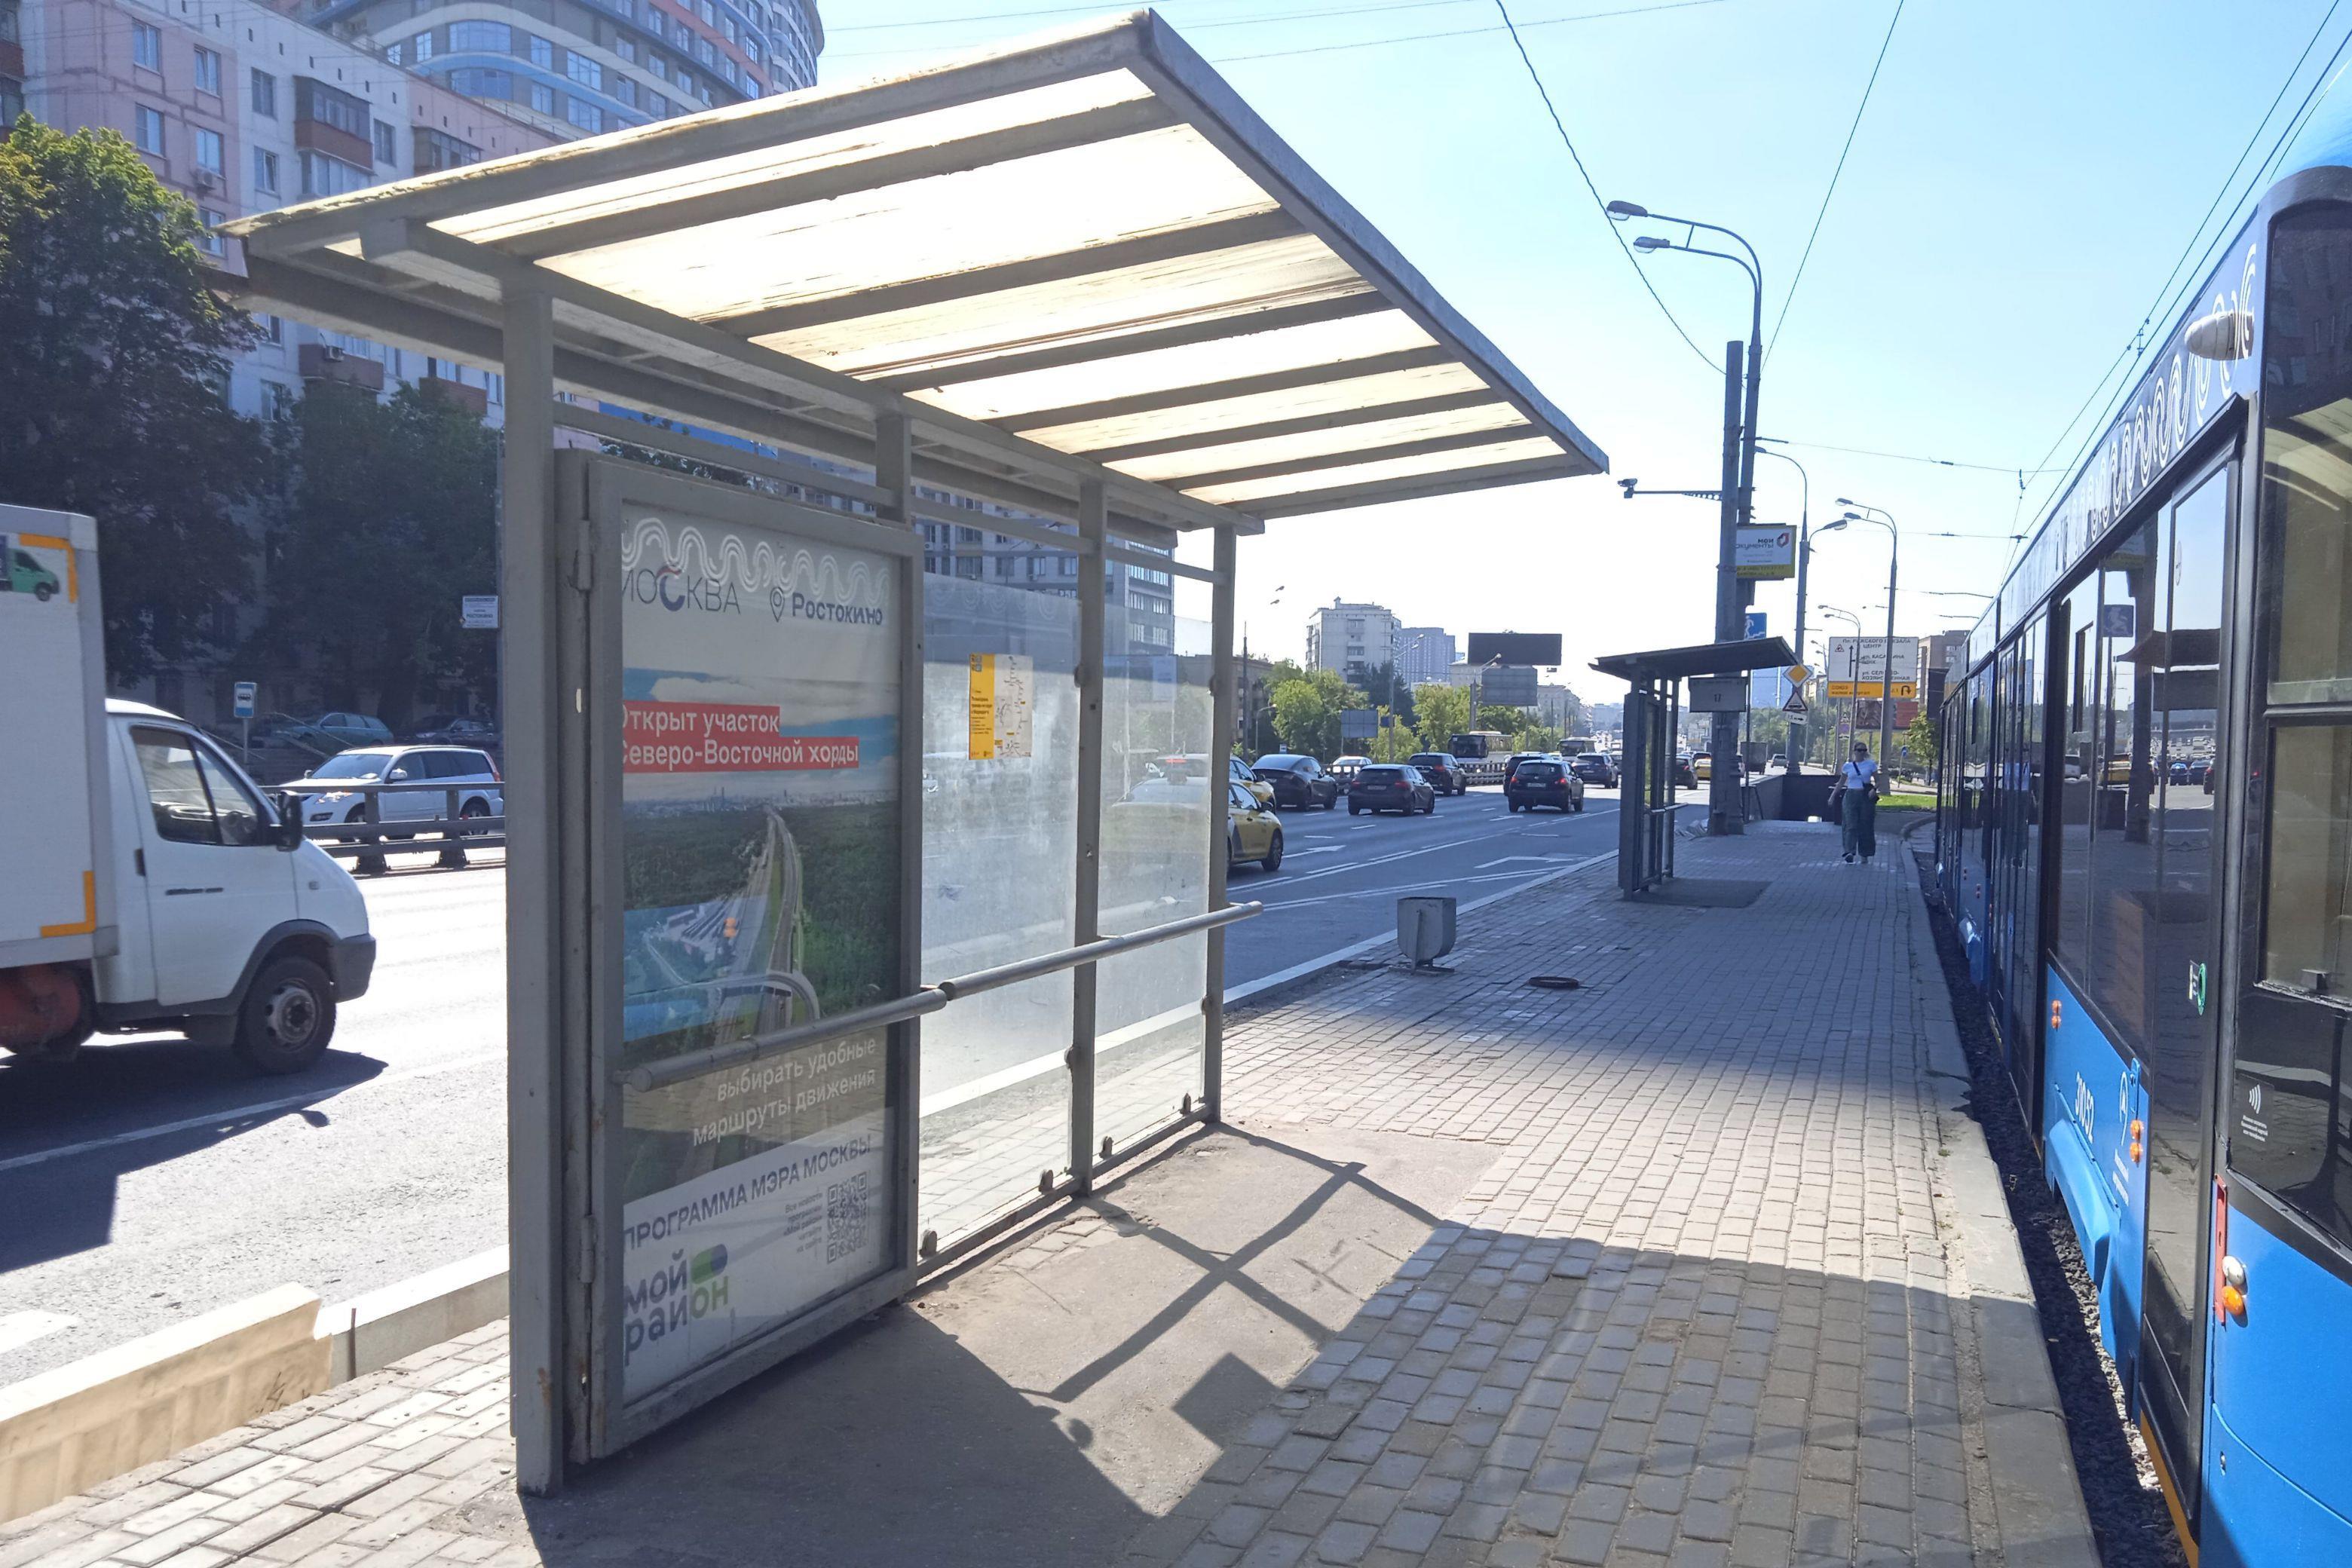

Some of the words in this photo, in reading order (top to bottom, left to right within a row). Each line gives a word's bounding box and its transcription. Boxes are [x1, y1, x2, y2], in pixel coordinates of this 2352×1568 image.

[703, 712, 779, 737] участок
[810, 744, 859, 767] хорды
[718, 1061, 804, 1102] выбирать
[807, 1038, 877, 1080] удобные
[693, 1097, 791, 1147] маршруты
[795, 1069, 875, 1113] движения
[752, 1162, 800, 1200] МЭРА
[803, 1134, 871, 1178] МОСКВЫ
